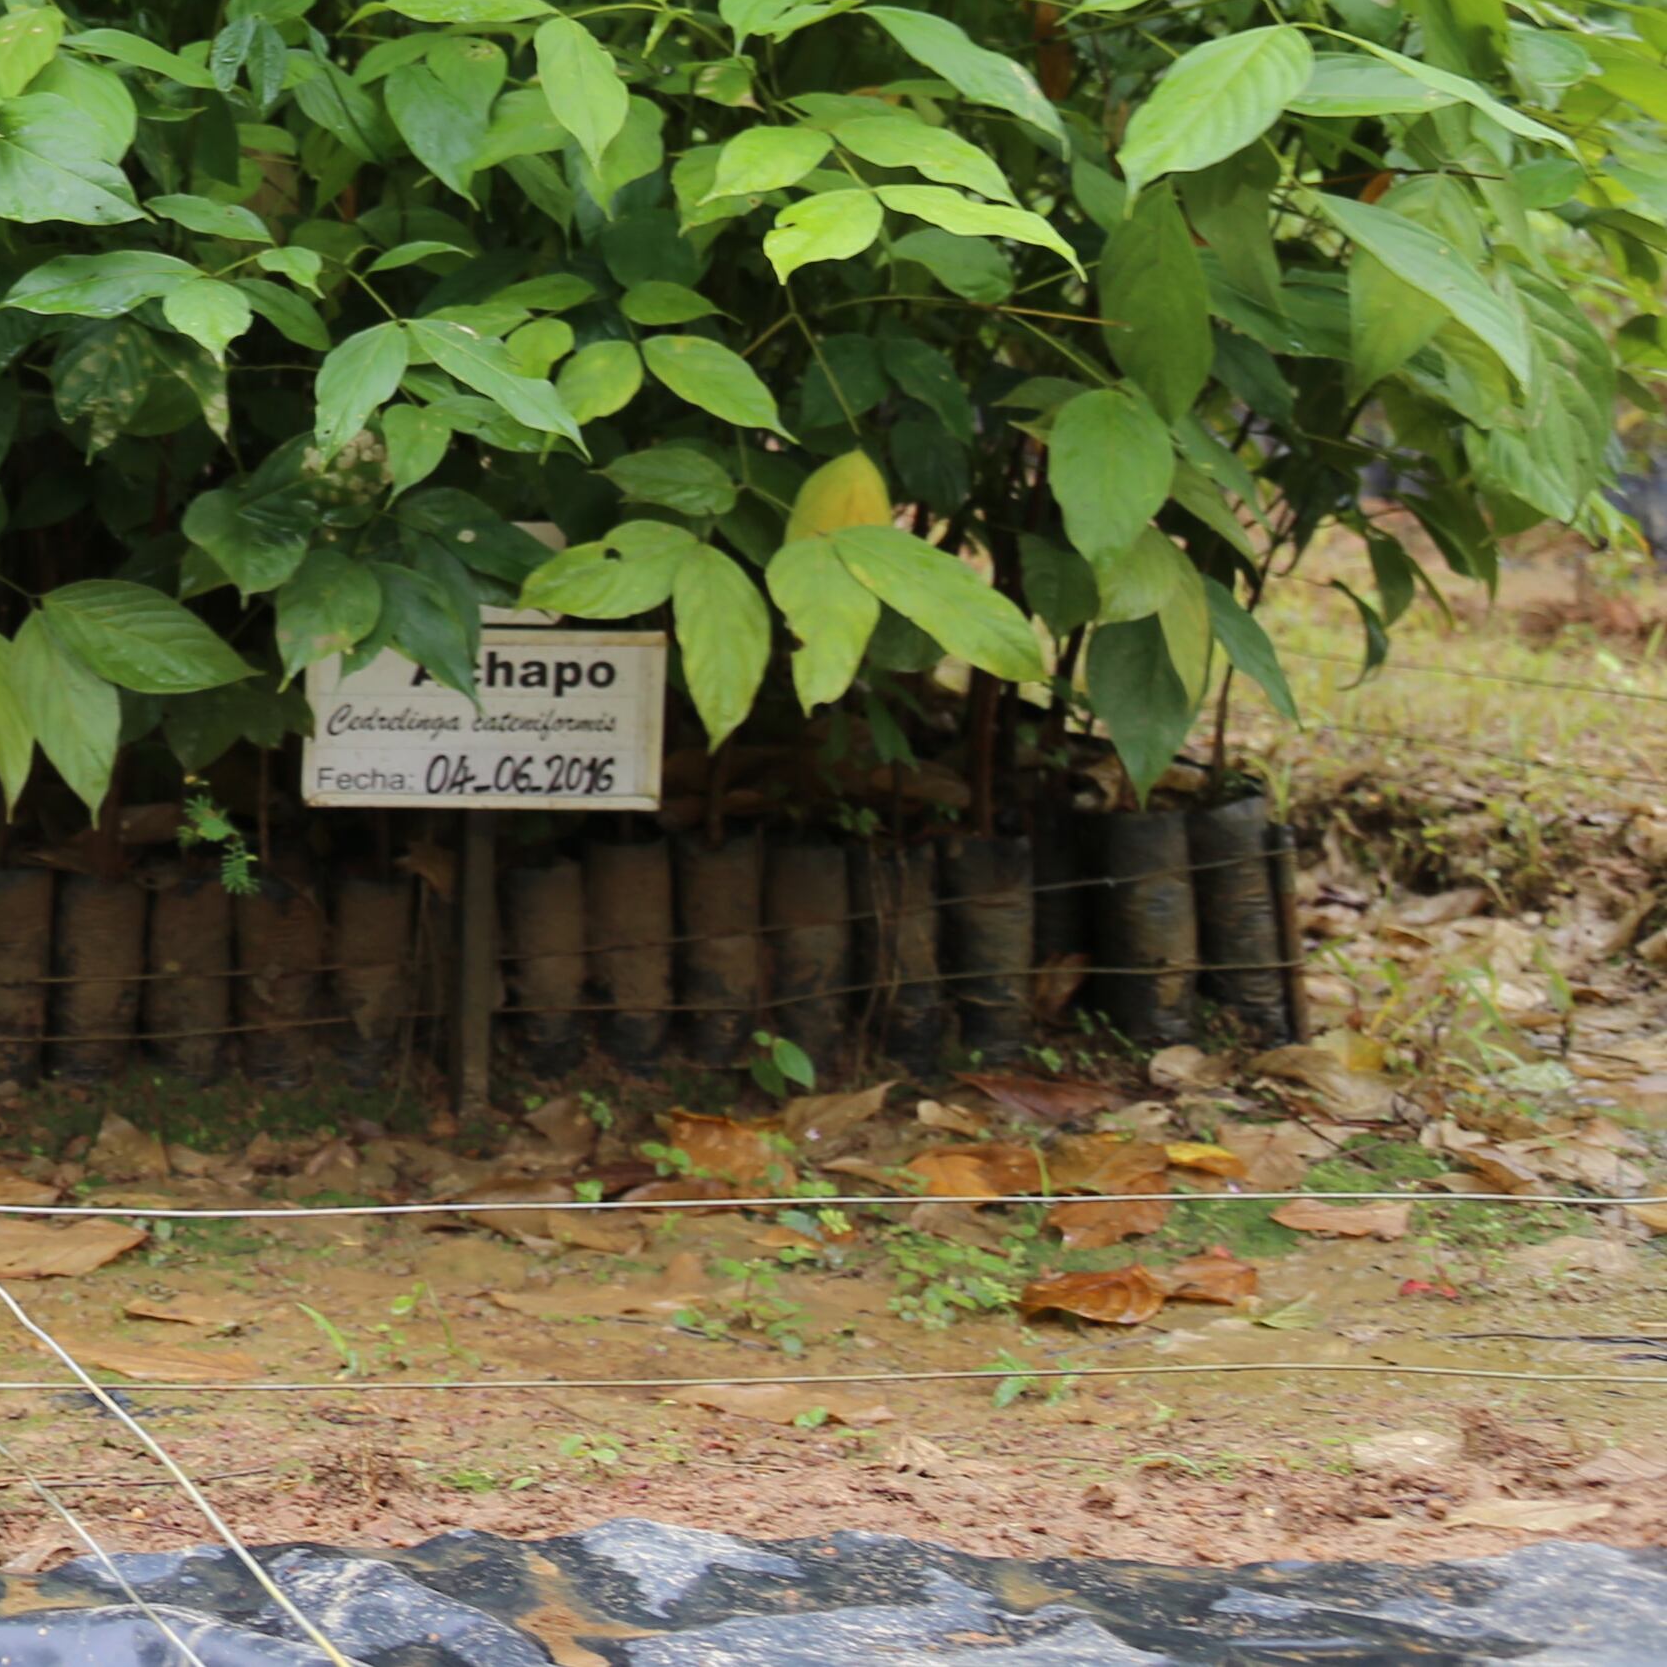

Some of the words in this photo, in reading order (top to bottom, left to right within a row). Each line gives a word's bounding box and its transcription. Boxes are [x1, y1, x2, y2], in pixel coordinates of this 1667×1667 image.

[411, 651, 616, 697] hapo
[327, 703, 460, 739] Cedrelinga
[471, 710, 617, 741] cateniformis
[317, 767, 413, 791] Fecha:
